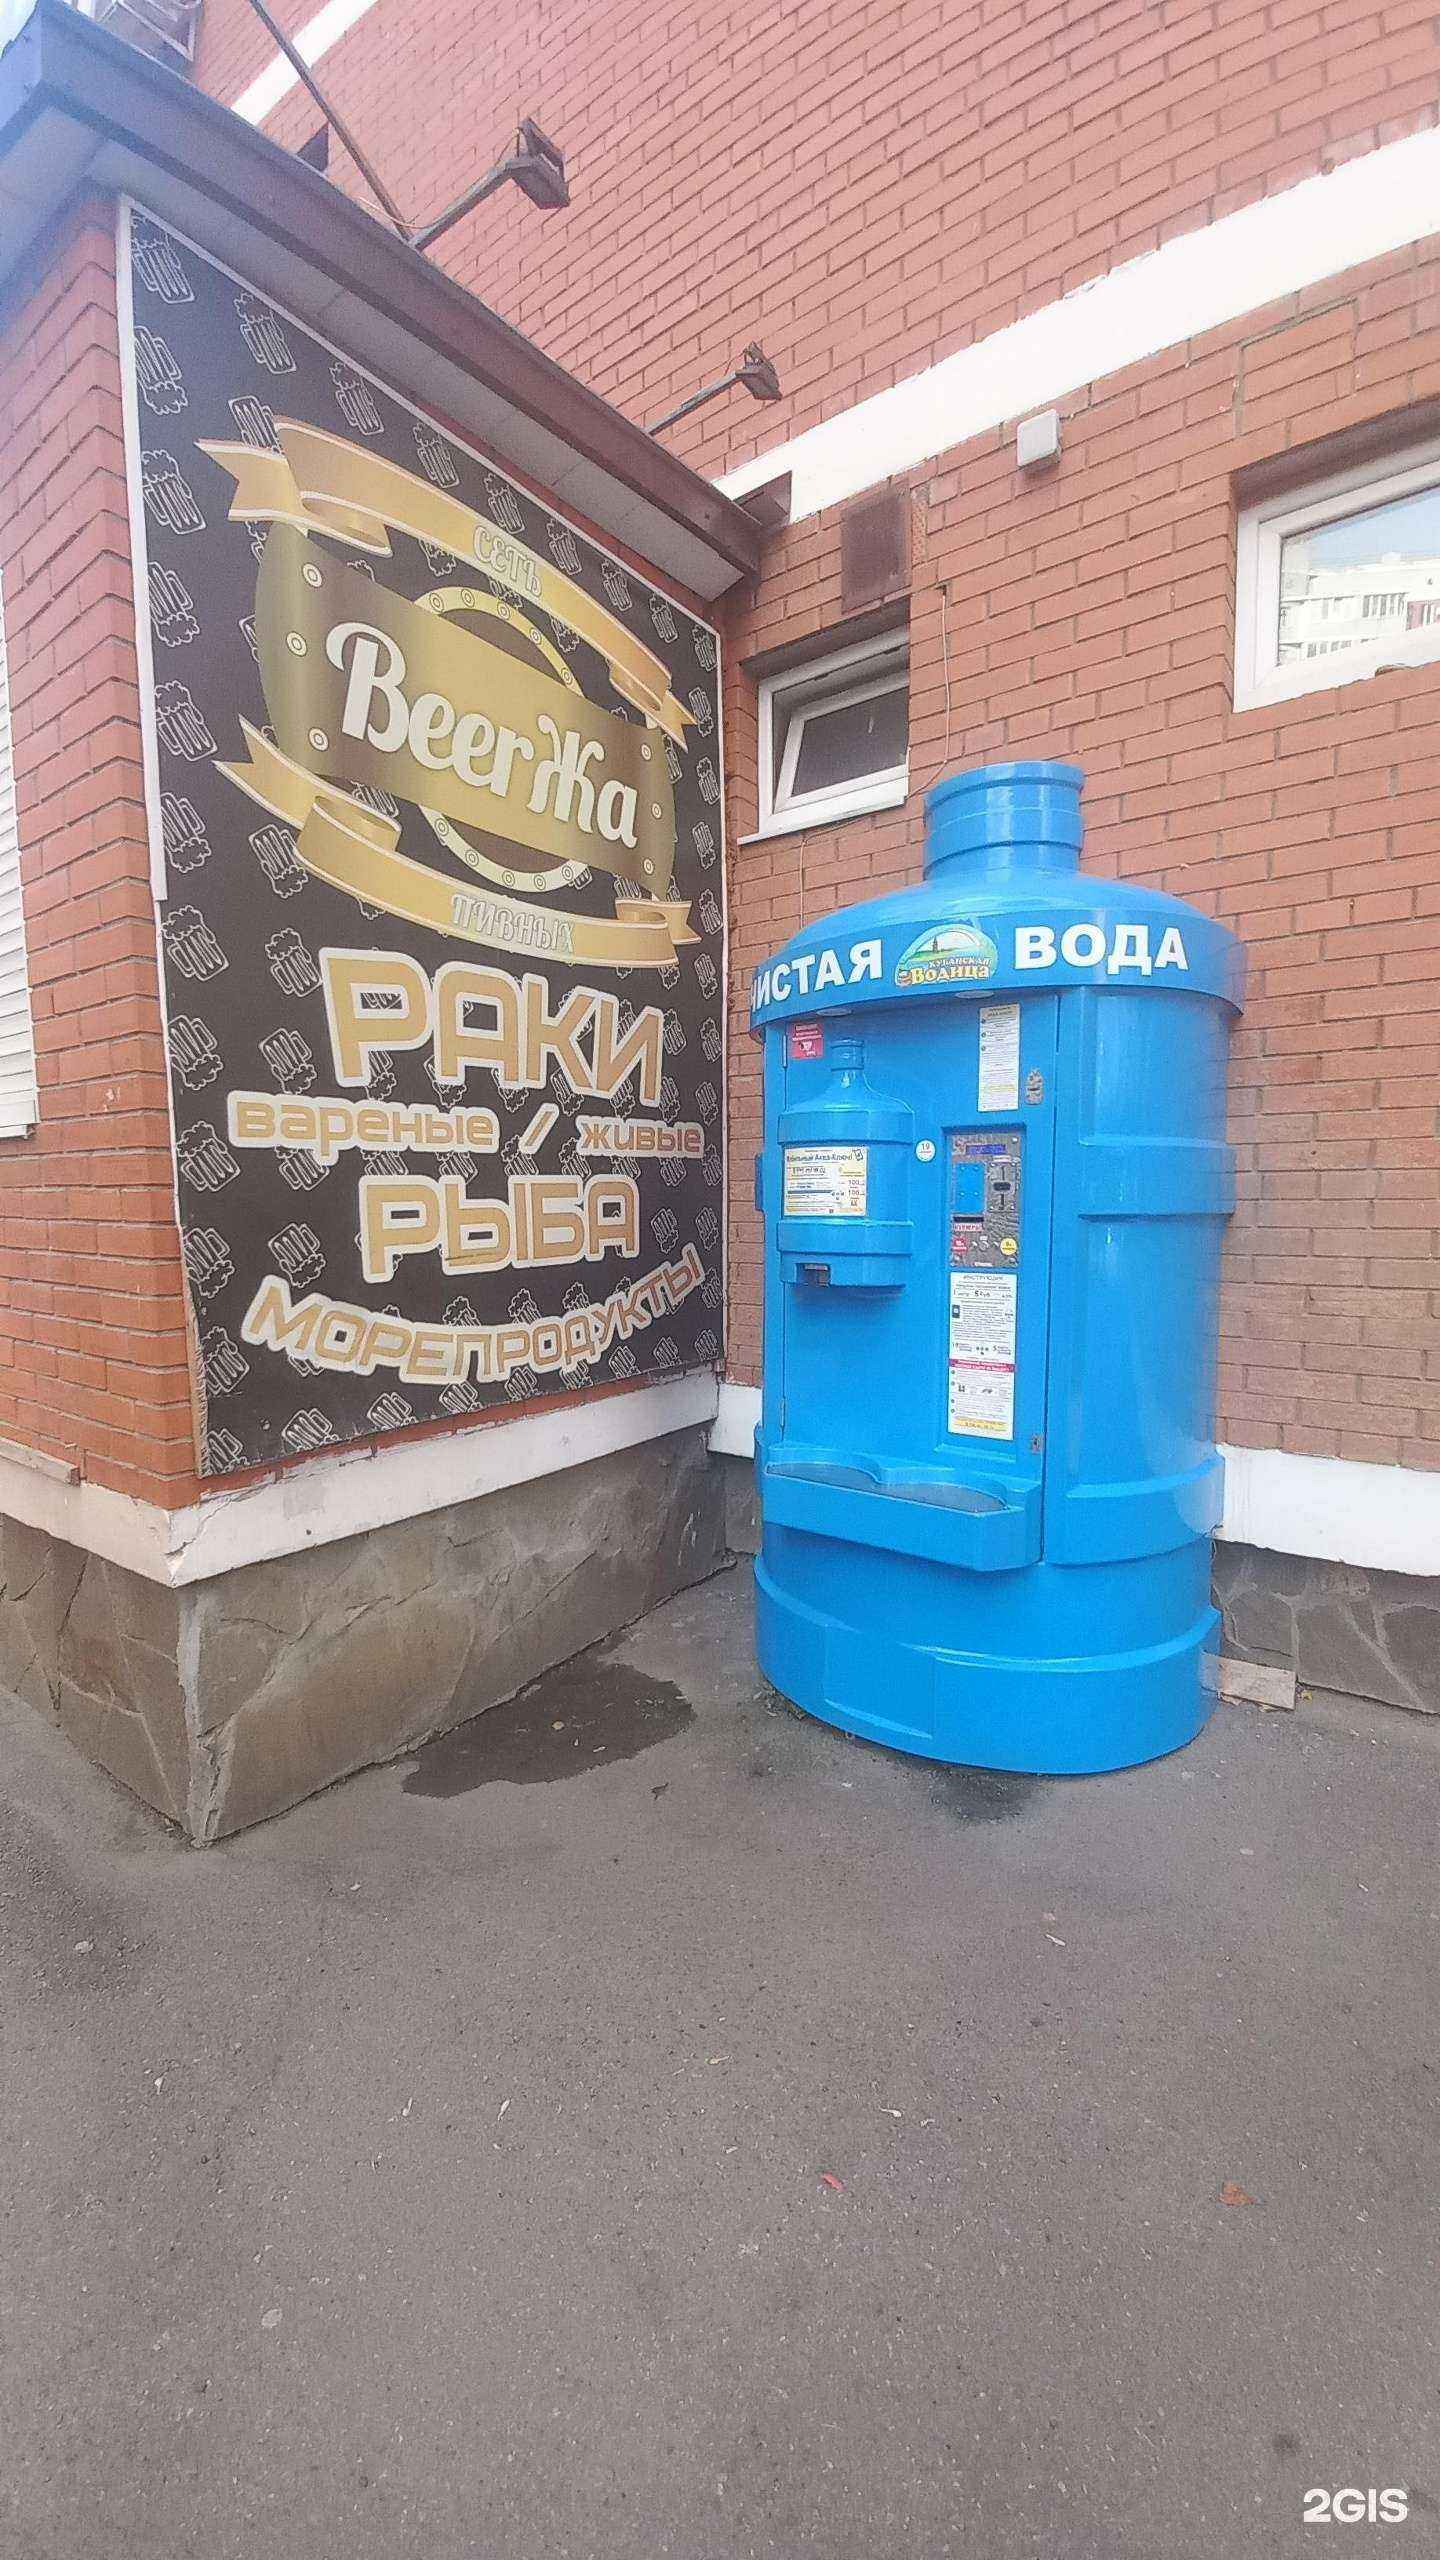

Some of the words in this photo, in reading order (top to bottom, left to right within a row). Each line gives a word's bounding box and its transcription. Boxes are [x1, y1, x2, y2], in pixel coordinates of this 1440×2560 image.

[472, 525, 543, 598] СЕТЬ
[451, 893, 576, 956] ПИВНЫХ
[1014, 923, 1189, 977] ВОДА
[320, 948, 665, 1106] РАКИ
[228, 1092, 499, 1164] вареные
[577, 1116, 704, 1158] живые
[359, 1175, 640, 1284] РЫБА
[242, 1243, 707, 1384] МОРЕПРОДУКТЫ
